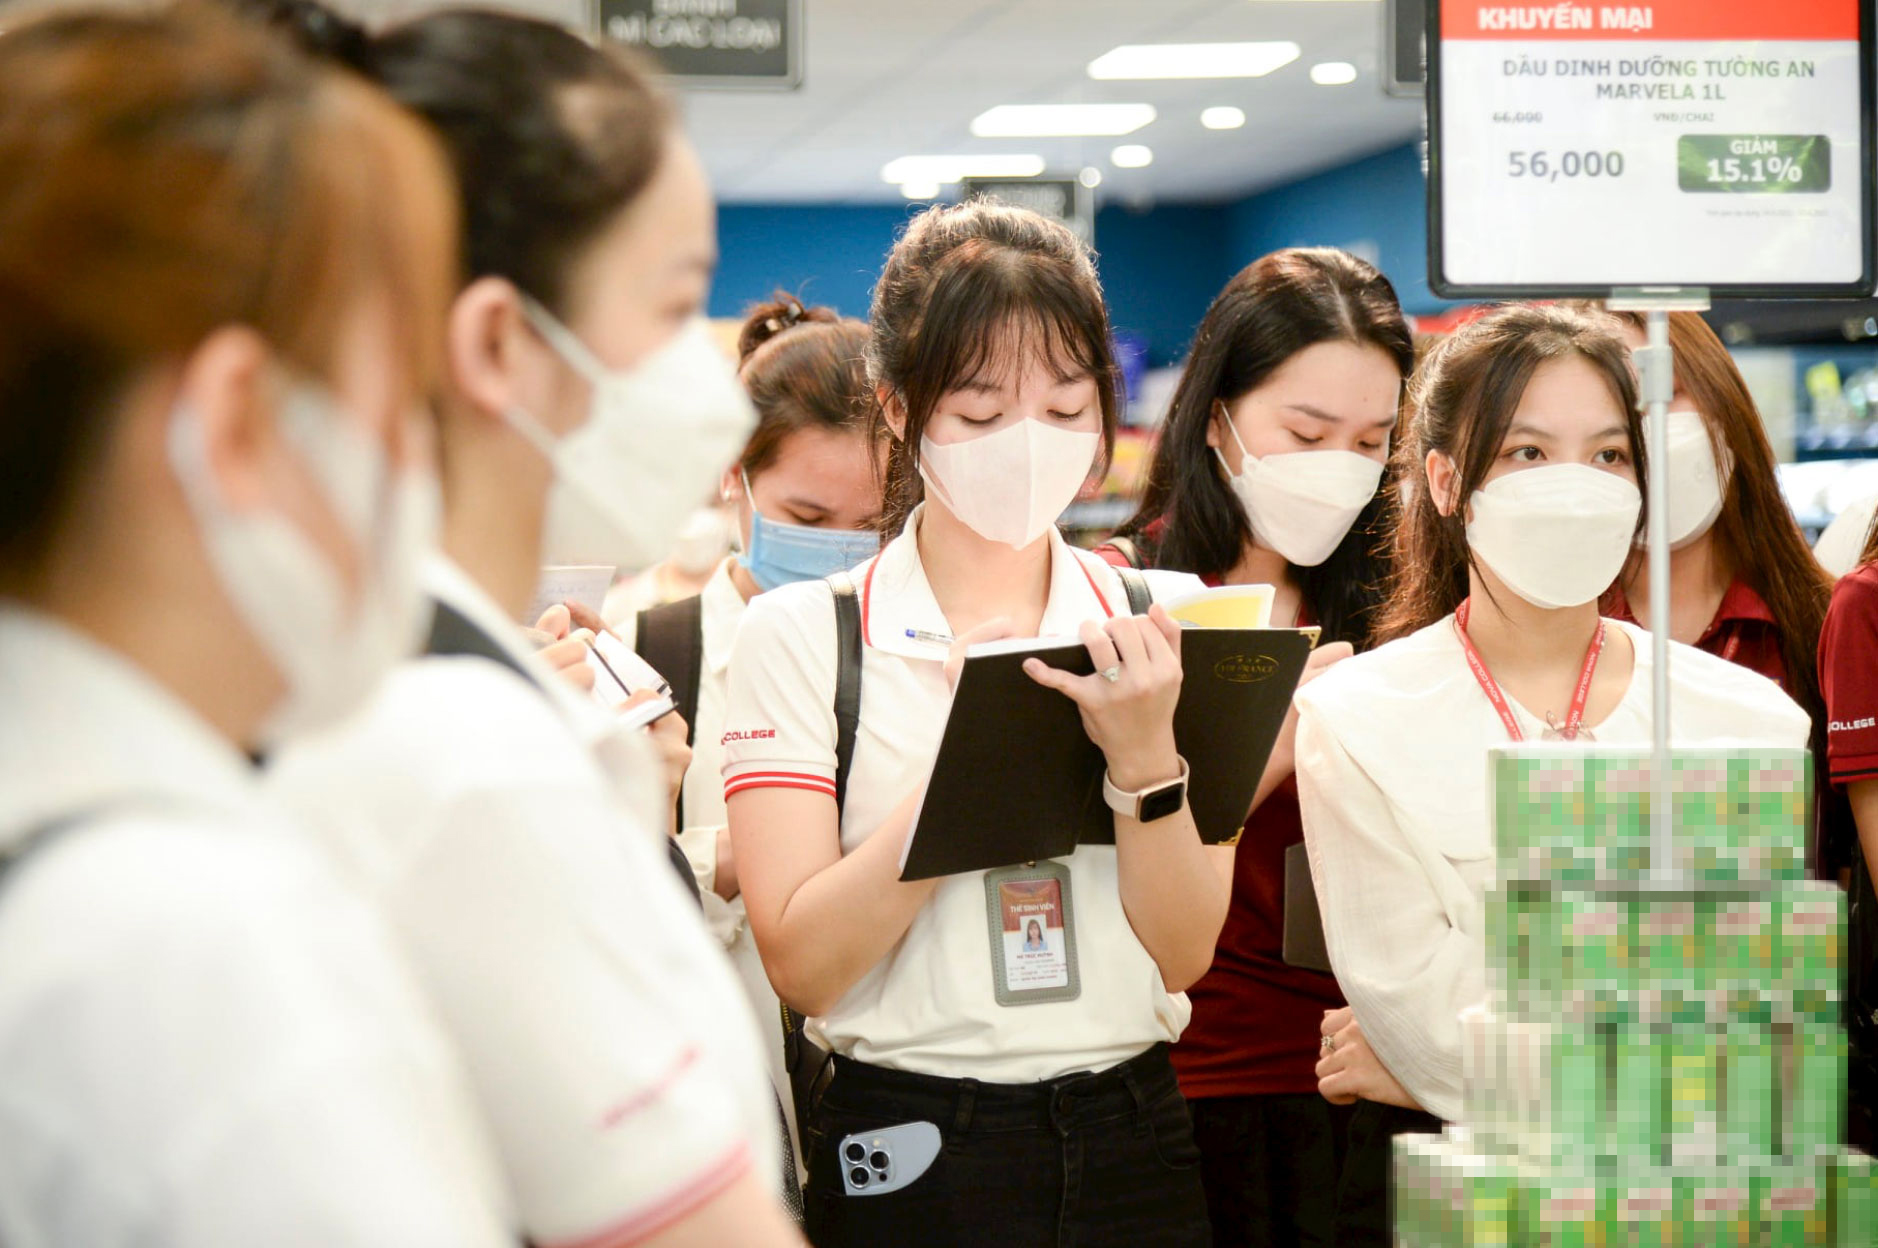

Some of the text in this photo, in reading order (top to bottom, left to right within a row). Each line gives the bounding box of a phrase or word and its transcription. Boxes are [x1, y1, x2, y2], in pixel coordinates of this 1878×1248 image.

[1478, 2, 1653, 32] KHUYẾN MẠI
[1555, 60, 1612, 77] DINH
[1619, 55, 1698, 77] DƯỠNG
[1787, 61, 1815, 78] AN
[1597, 83, 1727, 101] MARVELA 1L
[1730, 135, 1778, 155] GIẢM
[1507, 150, 1625, 184] 56,000
[1706, 156, 1803, 183] 15.1%
